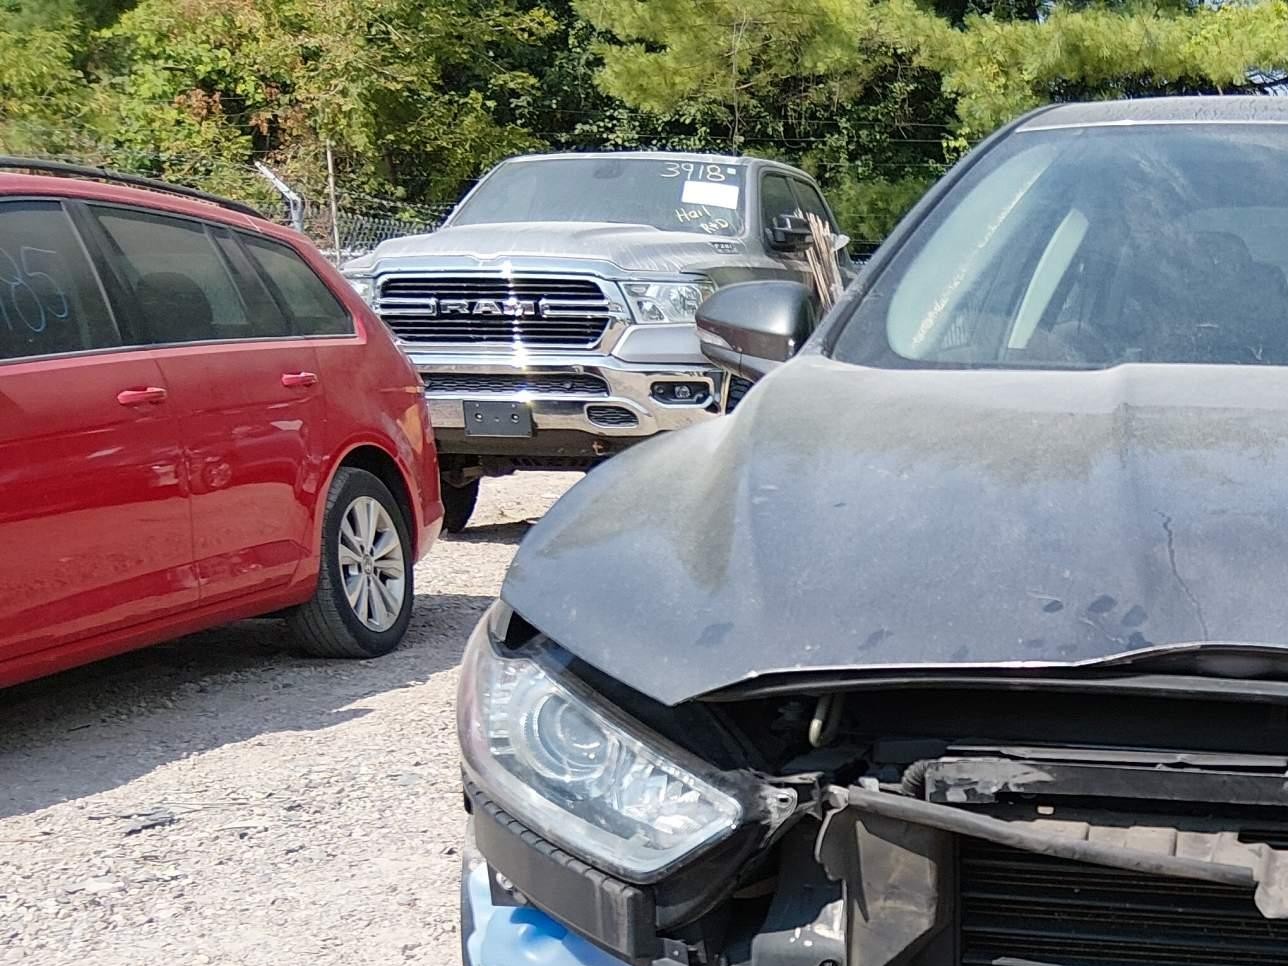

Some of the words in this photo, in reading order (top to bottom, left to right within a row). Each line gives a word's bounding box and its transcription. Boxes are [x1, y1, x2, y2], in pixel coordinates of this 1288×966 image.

[660, 161, 726, 181] 3918
[675, 204, 712, 223] Hail
[440, 300, 536, 316] RAM
